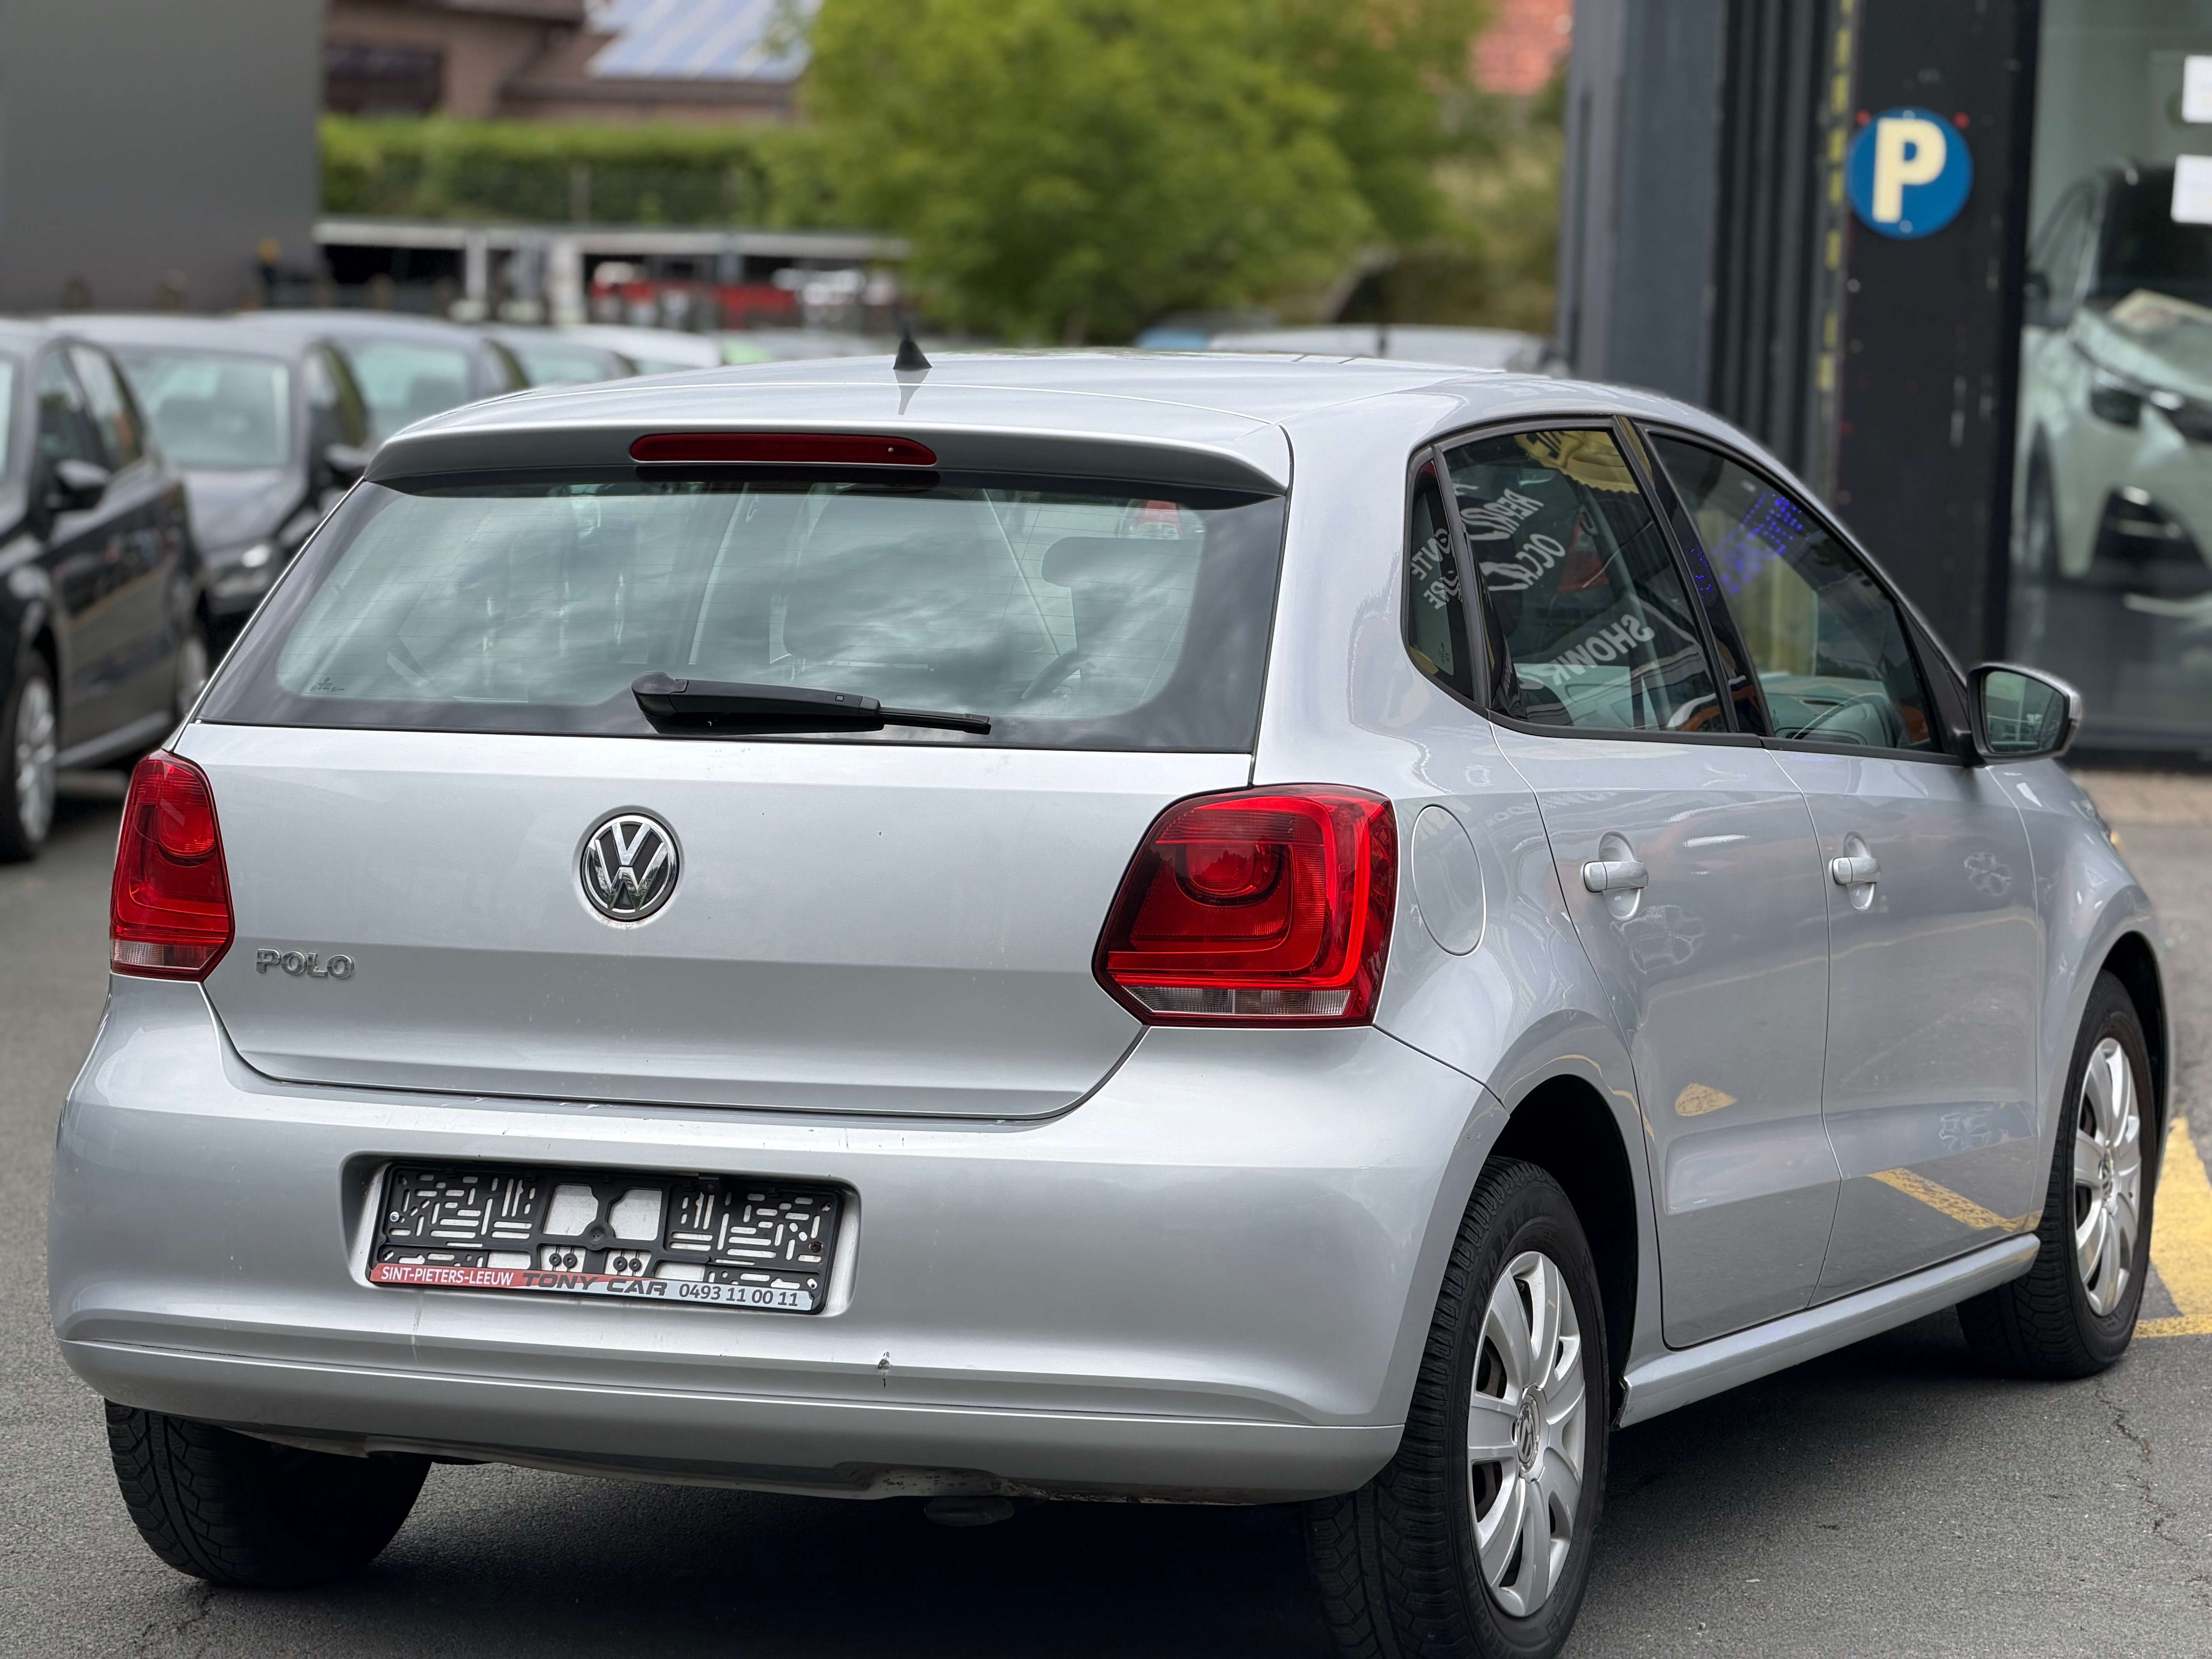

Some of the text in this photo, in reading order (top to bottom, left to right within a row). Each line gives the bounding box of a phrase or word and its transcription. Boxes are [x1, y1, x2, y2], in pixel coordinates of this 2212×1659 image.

[1872, 117, 1947, 223] P
[256, 948, 354, 979] POLO
[381, 1266, 798, 1307] SINT-PIETERS-LEEUW TONY CAR 0493 11 00 11
